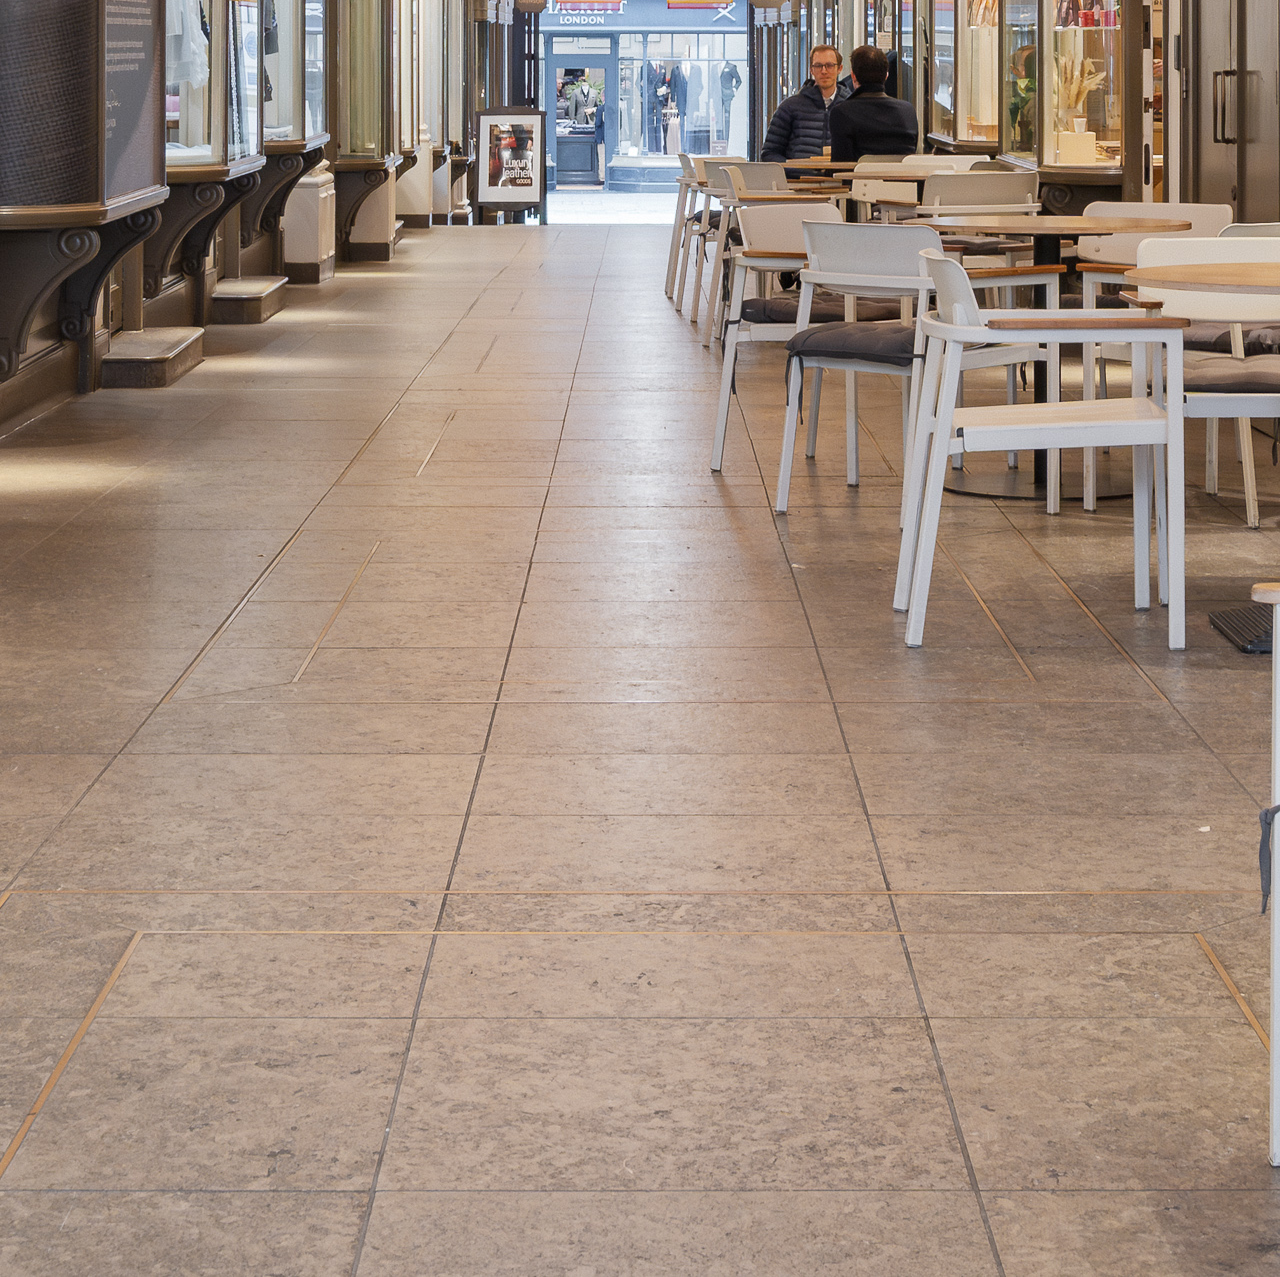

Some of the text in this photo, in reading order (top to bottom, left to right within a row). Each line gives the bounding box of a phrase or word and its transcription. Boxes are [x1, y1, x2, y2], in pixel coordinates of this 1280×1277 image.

[560, 16, 605, 25] LONDON
[503, 158, 530, 169] Luxury
[502, 168, 533, 178] leather
